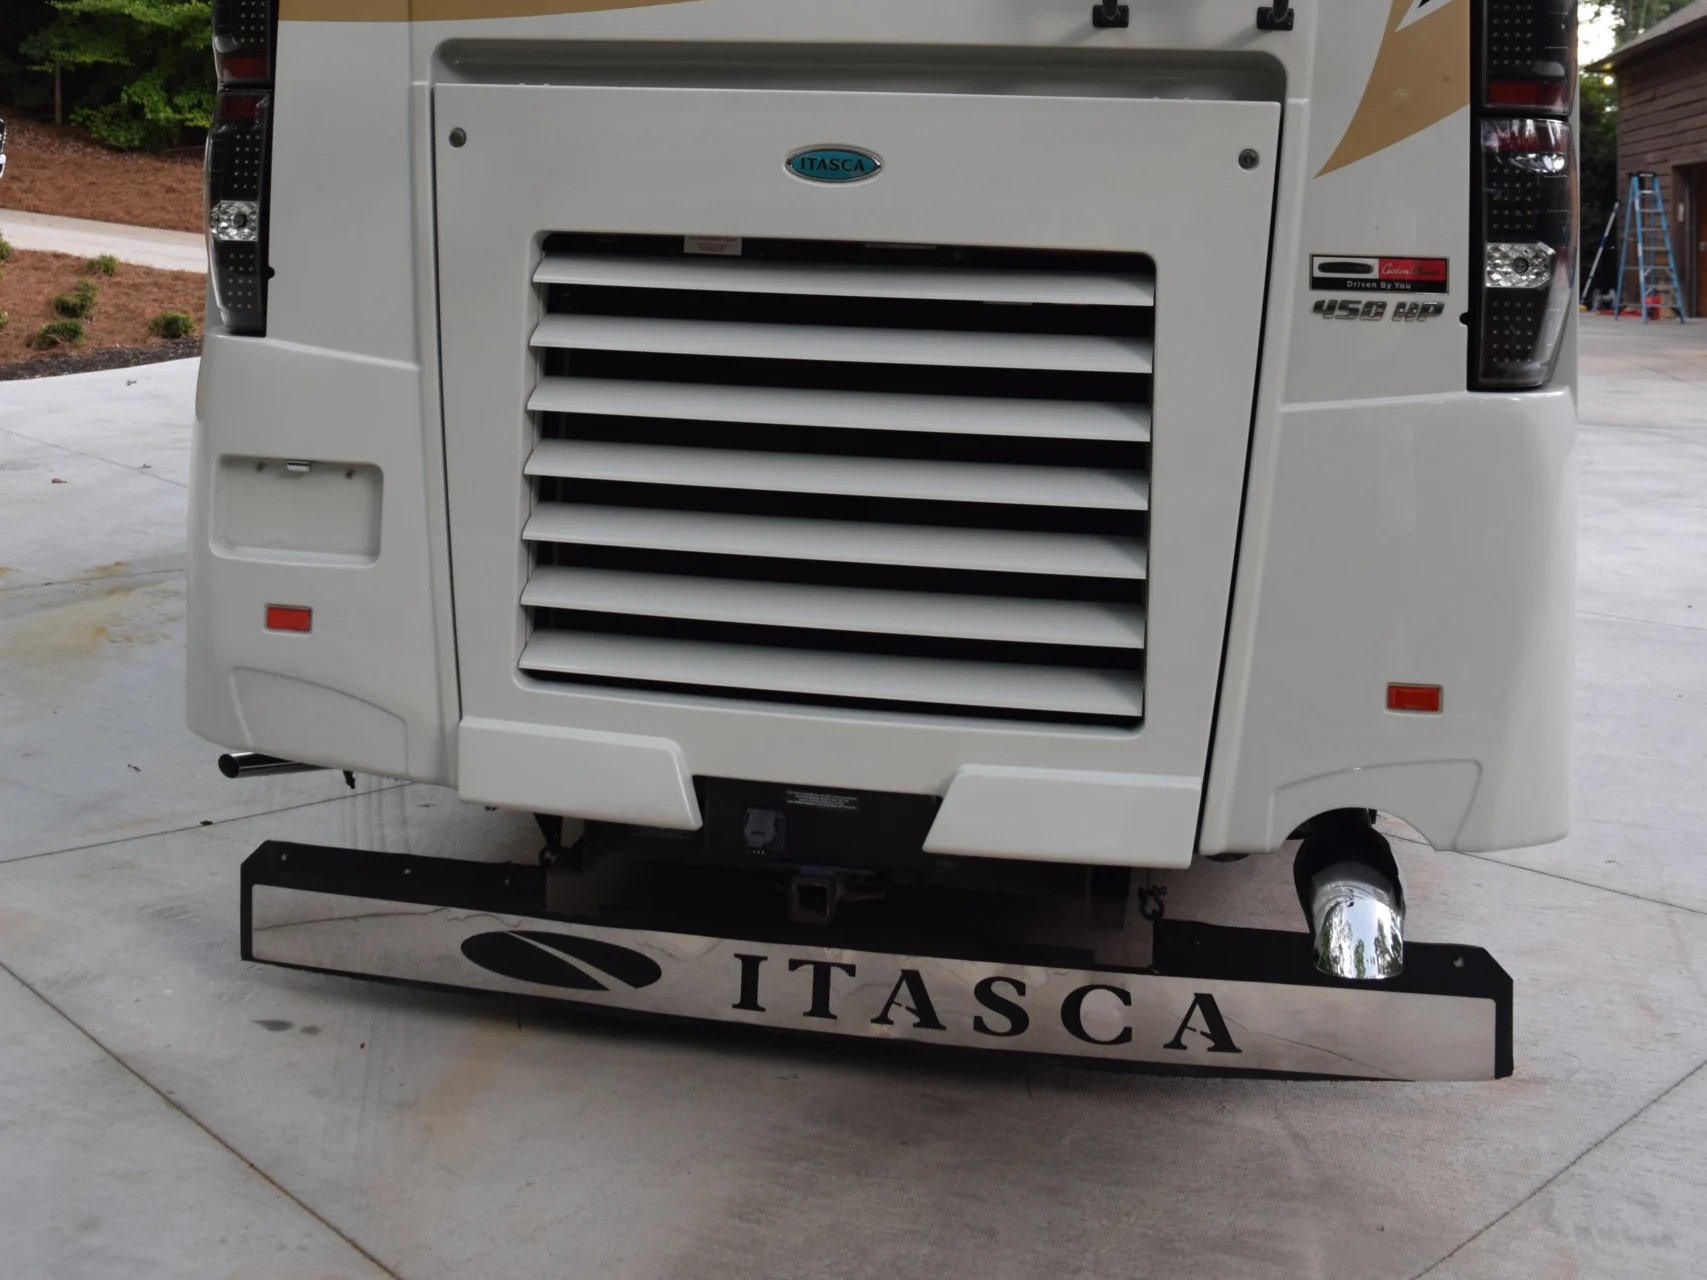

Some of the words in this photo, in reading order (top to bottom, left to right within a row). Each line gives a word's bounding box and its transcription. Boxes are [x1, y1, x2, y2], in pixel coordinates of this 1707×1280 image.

[799, 157, 866, 173] ITASCA
[1382, 263, 1410, 276] Custom
[1346, 280, 1377, 289] Driven
[1380, 281, 1391, 290] By
[1394, 281, 1411, 290] You
[1312, 299, 1388, 321] 450
[1392, 301, 1445, 322] HP
[731, 952, 1243, 1054] ITASCA
